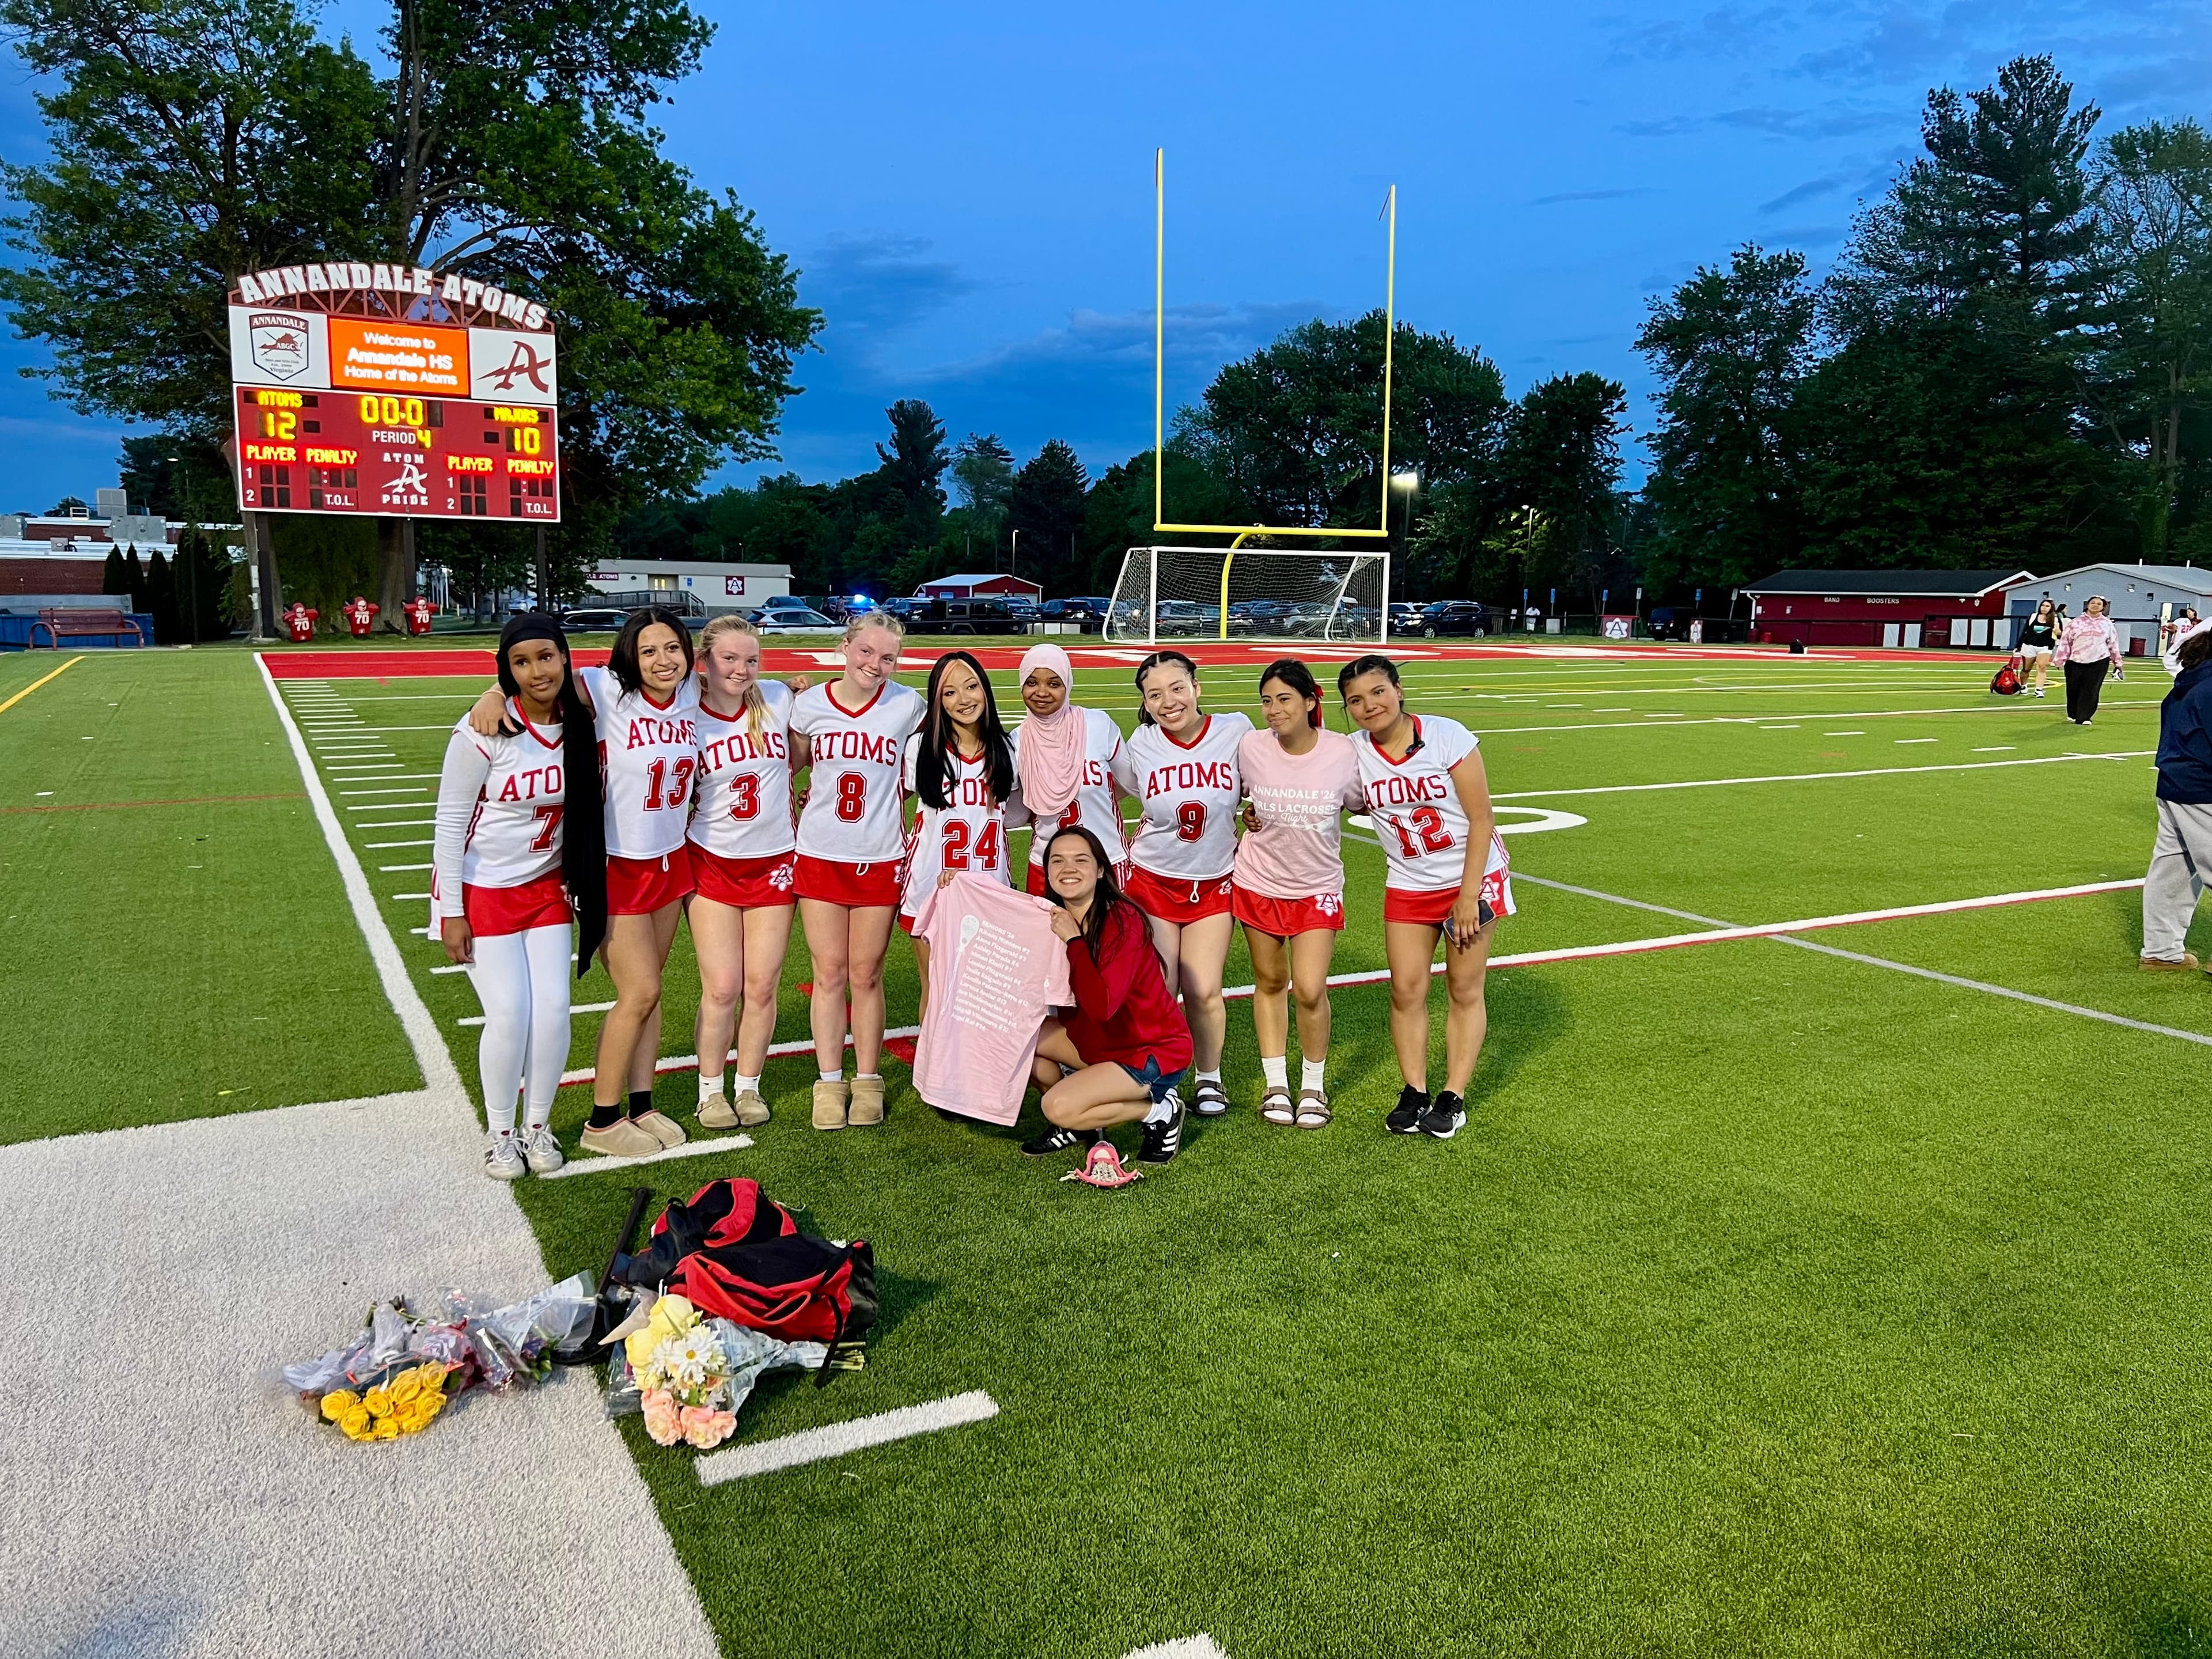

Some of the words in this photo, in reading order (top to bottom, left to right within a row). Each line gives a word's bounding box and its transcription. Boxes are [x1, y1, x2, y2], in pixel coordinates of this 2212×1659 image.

[237, 263, 434, 304] ANNANDALE
[441, 274, 547, 331] ATOMS
[252, 316, 306, 330] ANNANDALE
[276, 342, 296, 350] ABGC
[363, 332, 422, 349] Welcome
[423, 338, 436, 350] to
[347, 347, 427, 368] Annandale
[429, 353, 453, 370] HS
[343, 365, 382, 380] Home
[385, 369, 397, 380] of
[399, 369, 418, 382] the
[419, 371, 459, 385] Atoms
[257, 391, 303, 408] ATOMS
[494, 406, 540, 425] MAJORS
[266, 411, 296, 440] 12
[372, 430, 416, 444] PERIOD
[416, 429, 432, 449] 4
[514, 427, 541, 454] 10
[245, 445, 296, 462] PLAYER
[305, 449, 358, 465] PENALTY
[382, 452, 425, 464] ATOM
[245, 467, 252, 479] 1
[447, 456, 494, 472] PLAYER
[506, 459, 554, 475] PENALTY
[447, 477, 453, 488] 1
[245, 489, 255, 502] 2
[325, 494, 355, 506] T.O.L.
[382, 494, 429, 506] PRIDE
[446, 498, 455, 509] 2
[525, 503, 552, 514] T.O.L.
[294, 620, 310, 631] 70
[355, 613, 370, 624] 70
[415, 613, 430, 623] 70
[1609, 622, 1624, 635] A
[815, 731, 897, 767] ATOMS
[498, 764, 562, 802] ATO
[643, 756, 696, 812] 13
[1146, 762, 1233, 800] ATOMS
[728, 771, 760, 821] 3
[835, 771, 867, 823] 8
[1253, 784, 1319, 800] ANNANDALE
[1363, 774, 1447, 810] ATOMS
[528, 801, 565, 853] 7
[1175, 800, 1207, 843] 9
[1280, 812, 1308, 823] Night
[1388, 805, 1456, 860] 12
[941, 819, 1001, 871] 24
